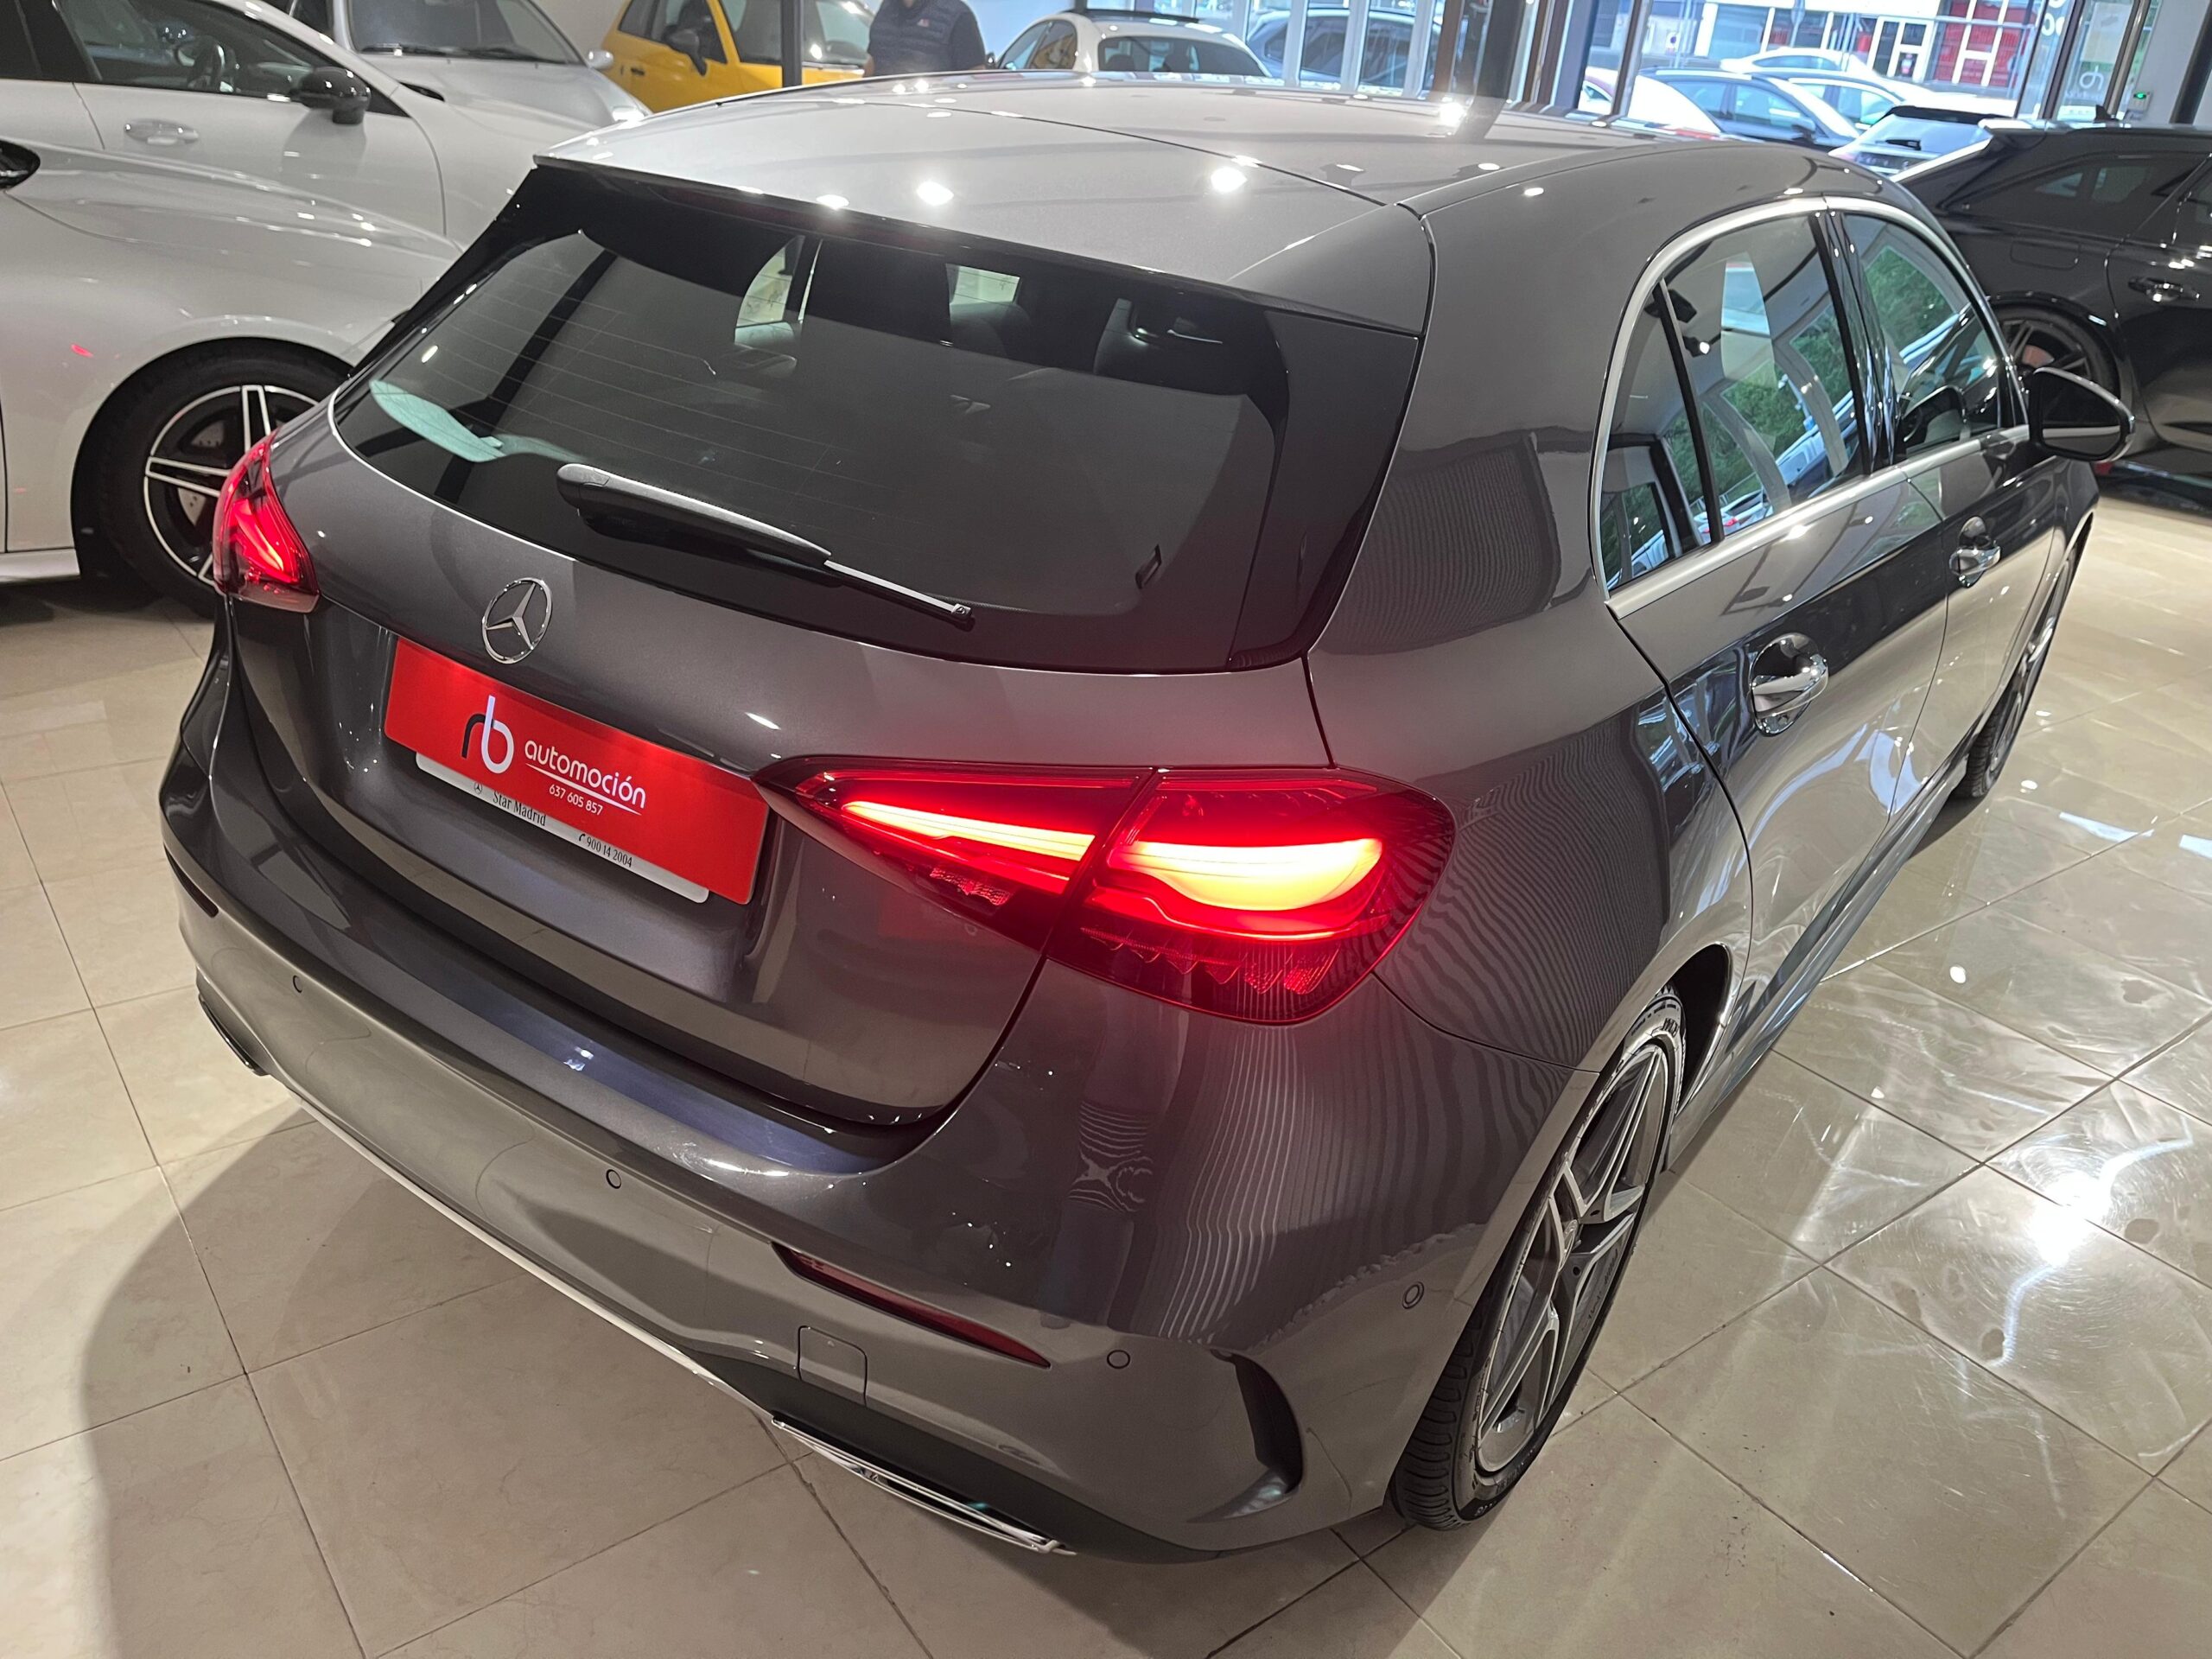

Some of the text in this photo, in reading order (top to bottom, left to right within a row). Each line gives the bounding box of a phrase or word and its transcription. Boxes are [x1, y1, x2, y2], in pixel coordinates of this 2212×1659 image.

[461, 695, 515, 774] rb
[524, 740, 646, 809] automoción
[493, 791, 547, 827] Star Madrid
[549, 784, 603, 816] 637 605 857
[587, 836, 632, 868] 900 14 2004
